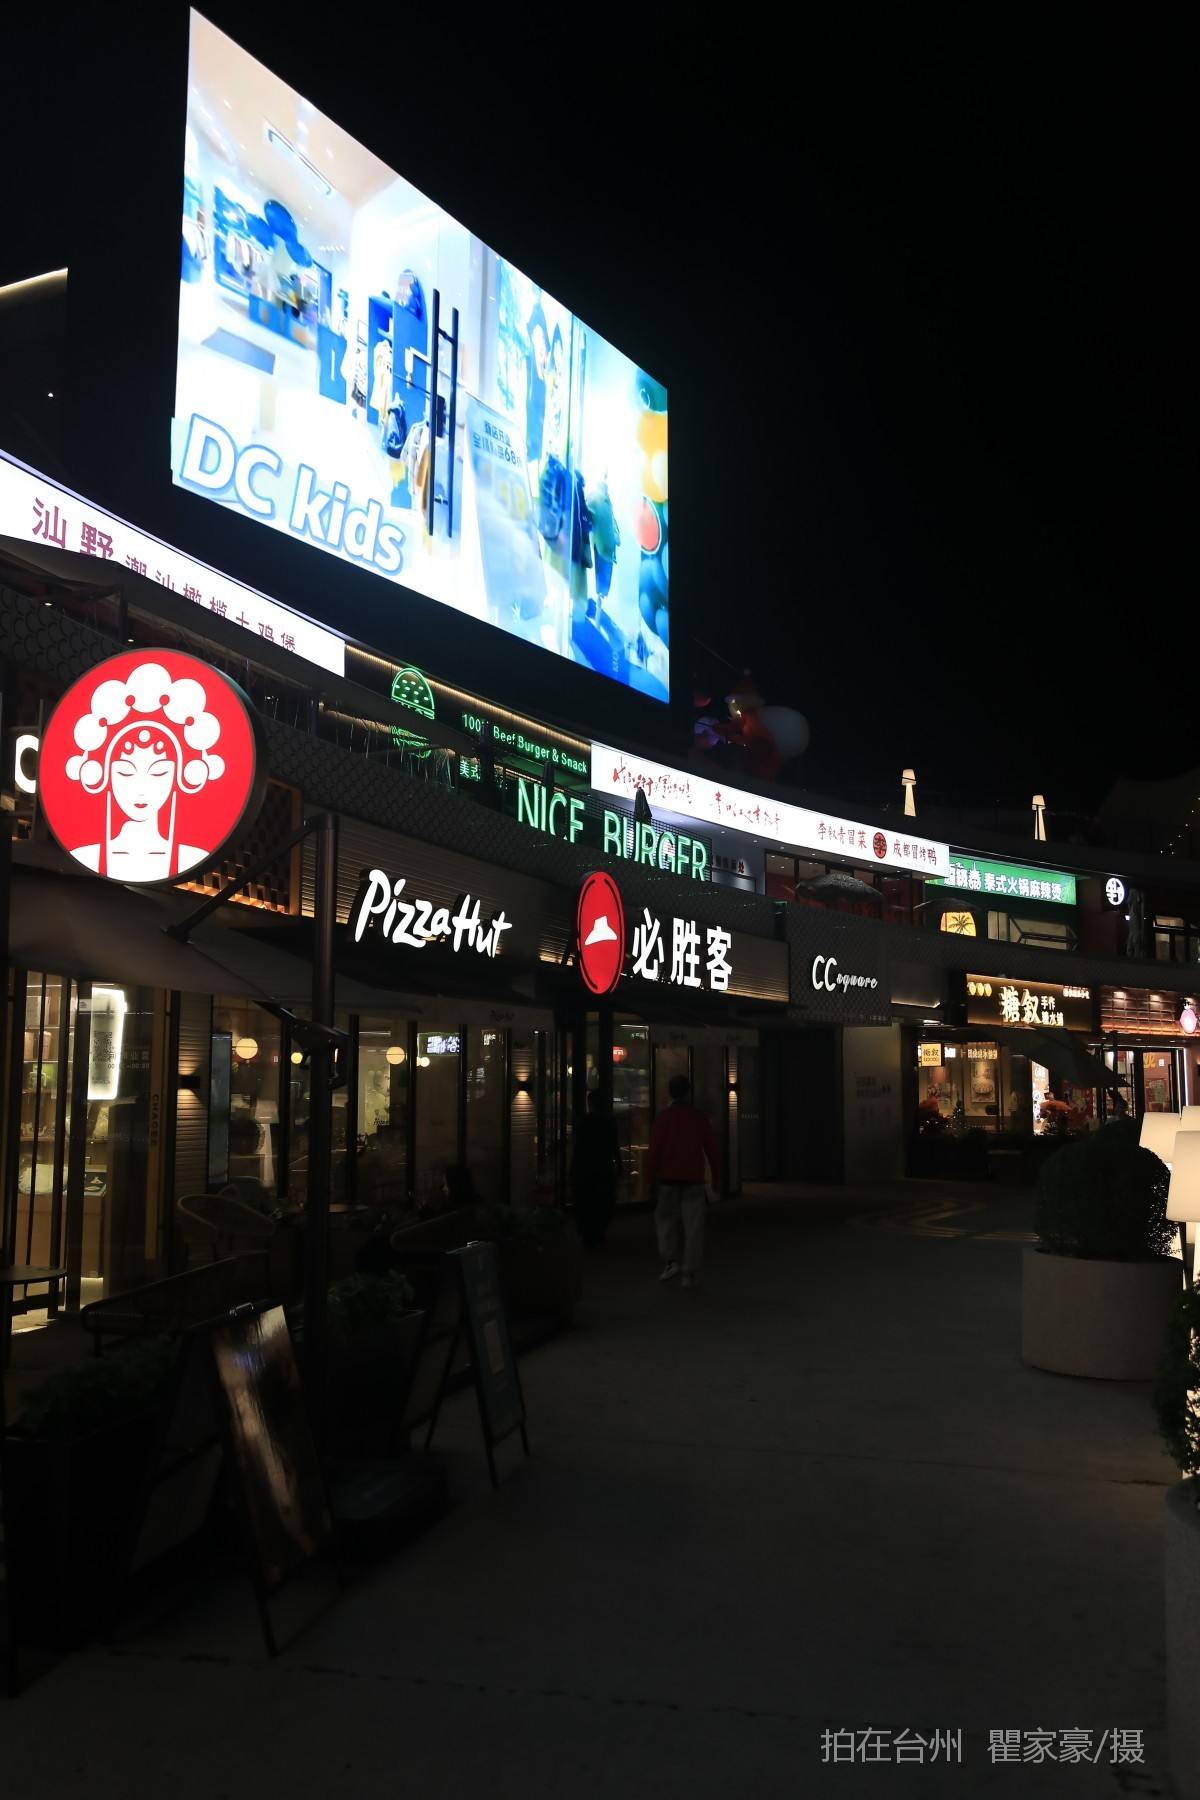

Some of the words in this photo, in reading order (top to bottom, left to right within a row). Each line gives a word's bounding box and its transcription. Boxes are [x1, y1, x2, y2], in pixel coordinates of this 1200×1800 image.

[180, 413, 282, 519] DC
[289, 463, 406, 575] kids
[517, 735, 550, 759] Burger
[552, 748, 559, 763] &
[561, 752, 587, 773] Snack
[355, 869, 451, 948] Pizza
[452, 894, 513, 958] Hut
[632, 907, 733, 991] 必胜客
